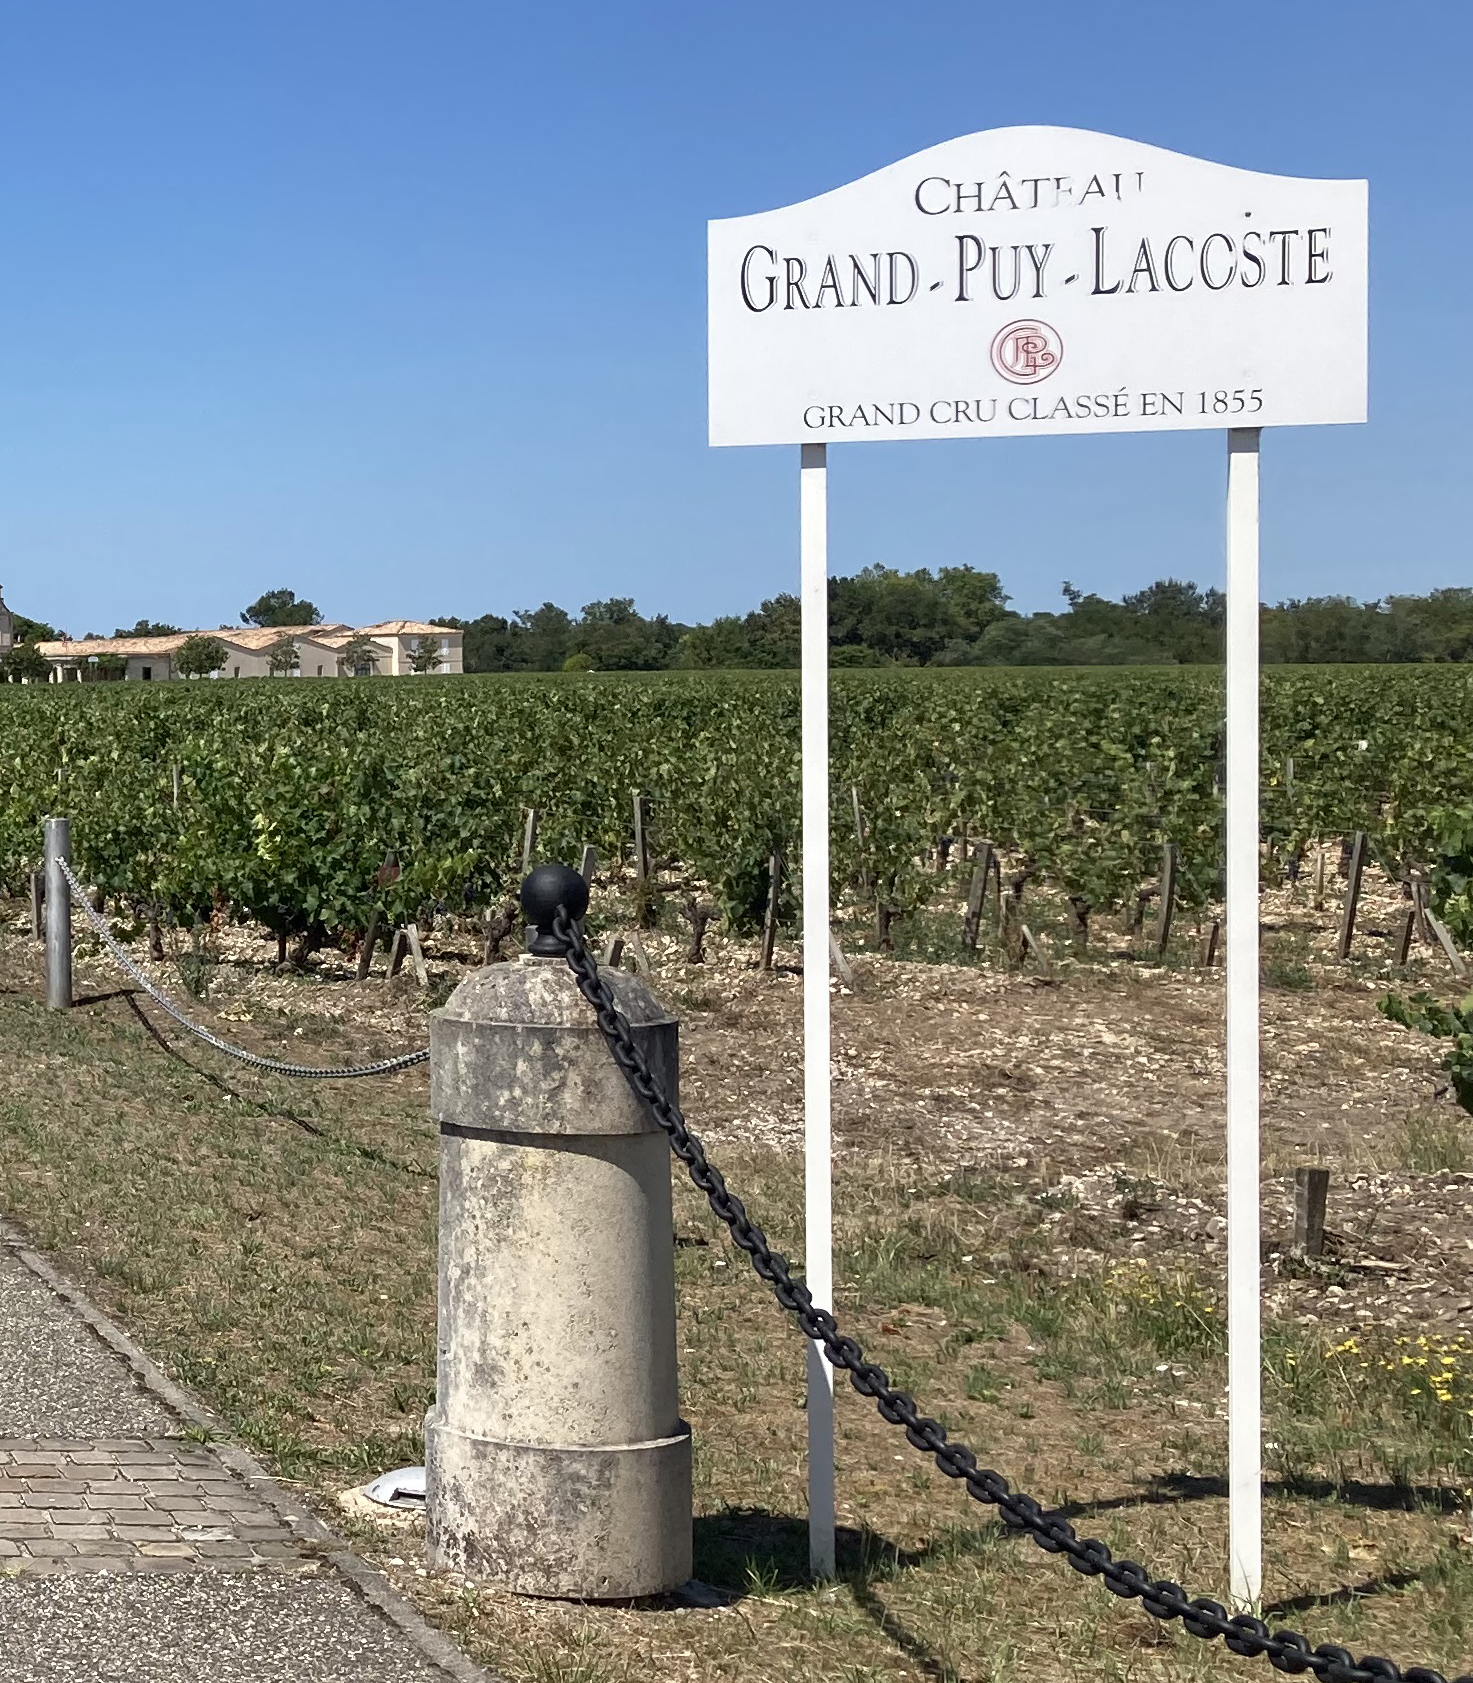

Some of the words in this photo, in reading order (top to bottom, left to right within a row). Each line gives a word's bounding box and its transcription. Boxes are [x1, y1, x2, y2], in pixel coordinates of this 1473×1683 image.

[803, 401, 921, 429] GRAND
[929, 399, 998, 424] CRU
[1008, 387, 1130, 421] CLASSÉ
[1140, 391, 1185, 416] EN
[1198, 388, 1264, 414] 1855
